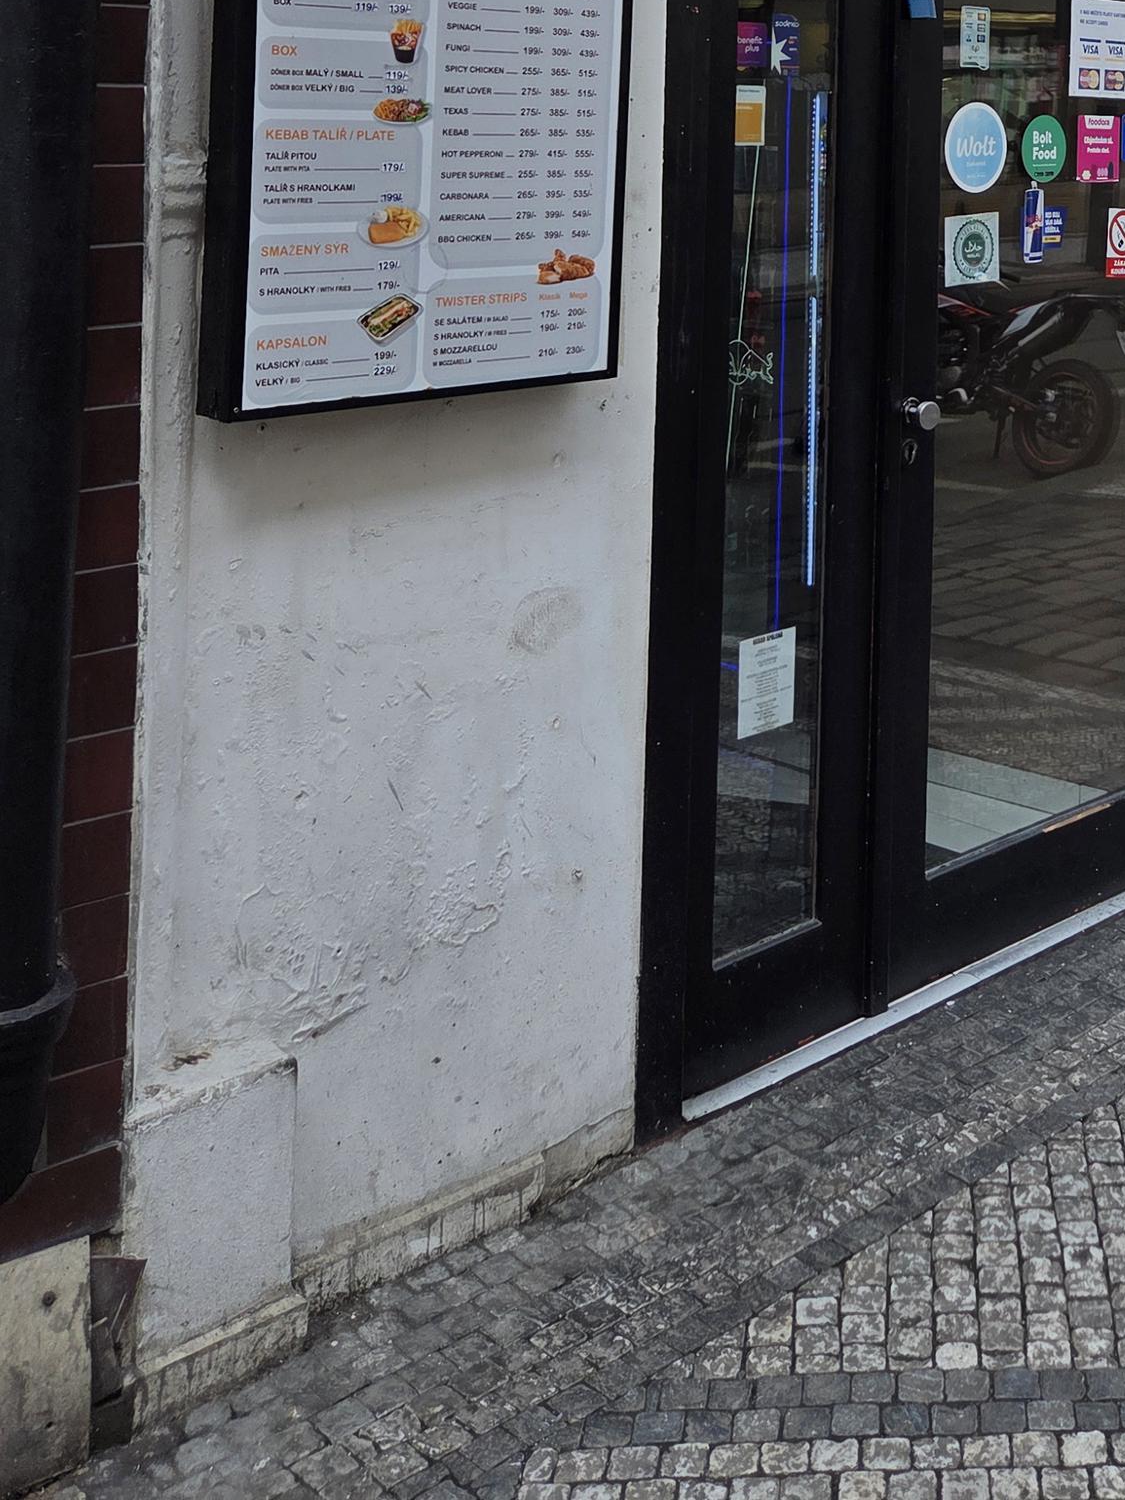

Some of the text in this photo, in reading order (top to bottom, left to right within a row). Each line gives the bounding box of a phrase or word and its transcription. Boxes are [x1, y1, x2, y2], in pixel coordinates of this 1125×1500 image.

[448, 2, 477, 10] VEGGIE
[447, 23, 481, 31] SPINACH
[271, 45, 297, 56] BOX
[745, 43, 760, 53] plus
[1083, 44, 1099, 54] VISA
[1108, 46, 1123, 55] VISA
[305, 68, 329, 77] MALÝ
[445, 65, 468, 73] SPICY
[470, 66, 504, 74] CHICKEN
[305, 83, 355, 93] VELKÝ BIG
[467, 87, 492, 95] LOVER
[265, 128, 395, 141] KEBAB TALÍŘ PLATE
[1033, 131, 1052, 144] Bolt
[957, 135, 996, 158] Wolt
[291, 152, 317, 160] PITOU
[1033, 146, 1056, 160] Food
[297, 184, 355, 192] HRANOLKAMI
[457, 234, 492, 242] CHICKEN
[964, 241, 983, 253] حلال
[260, 267, 279, 275] PITA
[267, 286, 316, 296] HRANOLKY
[435, 292, 528, 308] TWISTER STRIPS
[441, 331, 483, 340] HRANOLKY
[256, 336, 327, 351] KAPSALON
[440, 344, 497, 354] MOZZARELLOU
